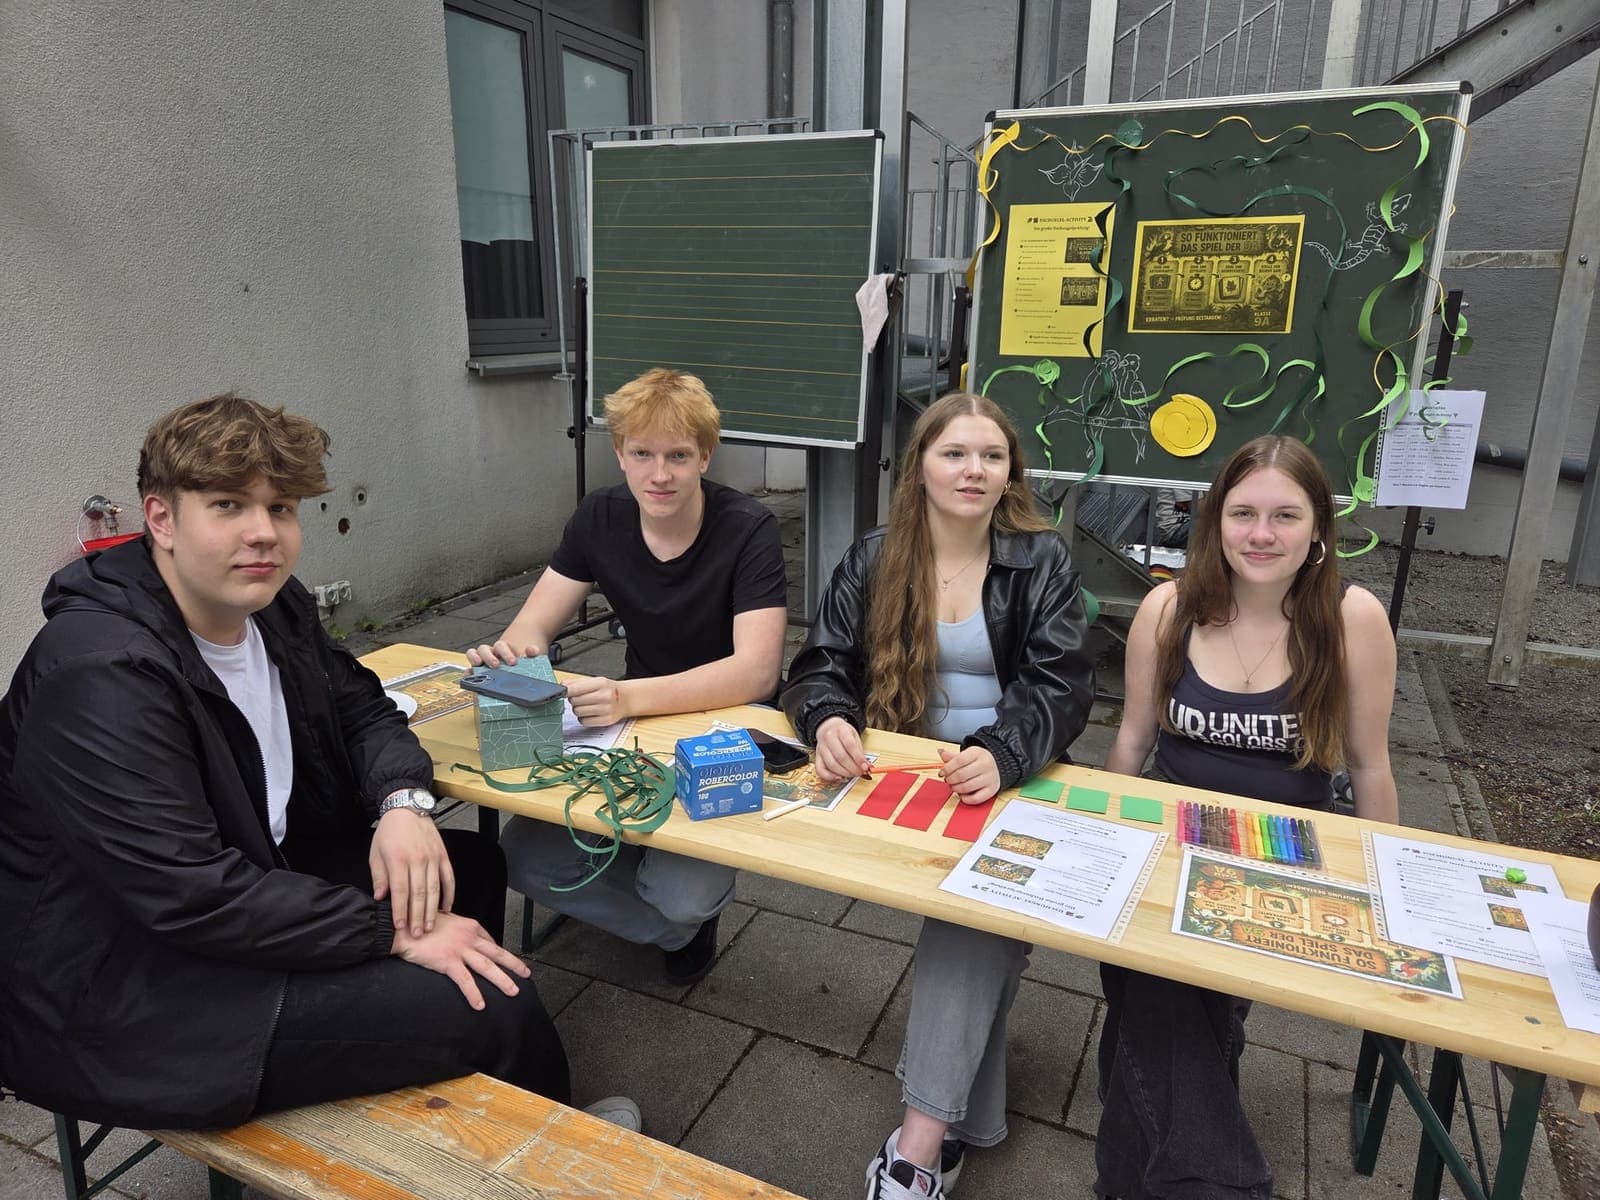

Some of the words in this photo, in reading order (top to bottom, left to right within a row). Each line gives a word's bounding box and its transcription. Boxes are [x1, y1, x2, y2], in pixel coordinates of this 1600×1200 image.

[1181, 232, 1193, 242] SO
[1195, 231, 1257, 242] FUNKTIONIERT
[1181, 243, 1198, 253] DAS
[1201, 242, 1223, 252] SPIEL
[1226, 242, 1241, 251] DER
[1254, 317, 1270, 326] 9A
[1209, 732, 1288, 751] COLORS
[698, 771, 759, 786] ROBERCOLOR
[1270, 931, 1294, 942] DER
[1246, 935, 1350, 965] FUNKTIONIERT
[1300, 939, 1337, 952] SPIEL
[1343, 947, 1373, 960] DAS
[1356, 959, 1377, 970] SO
